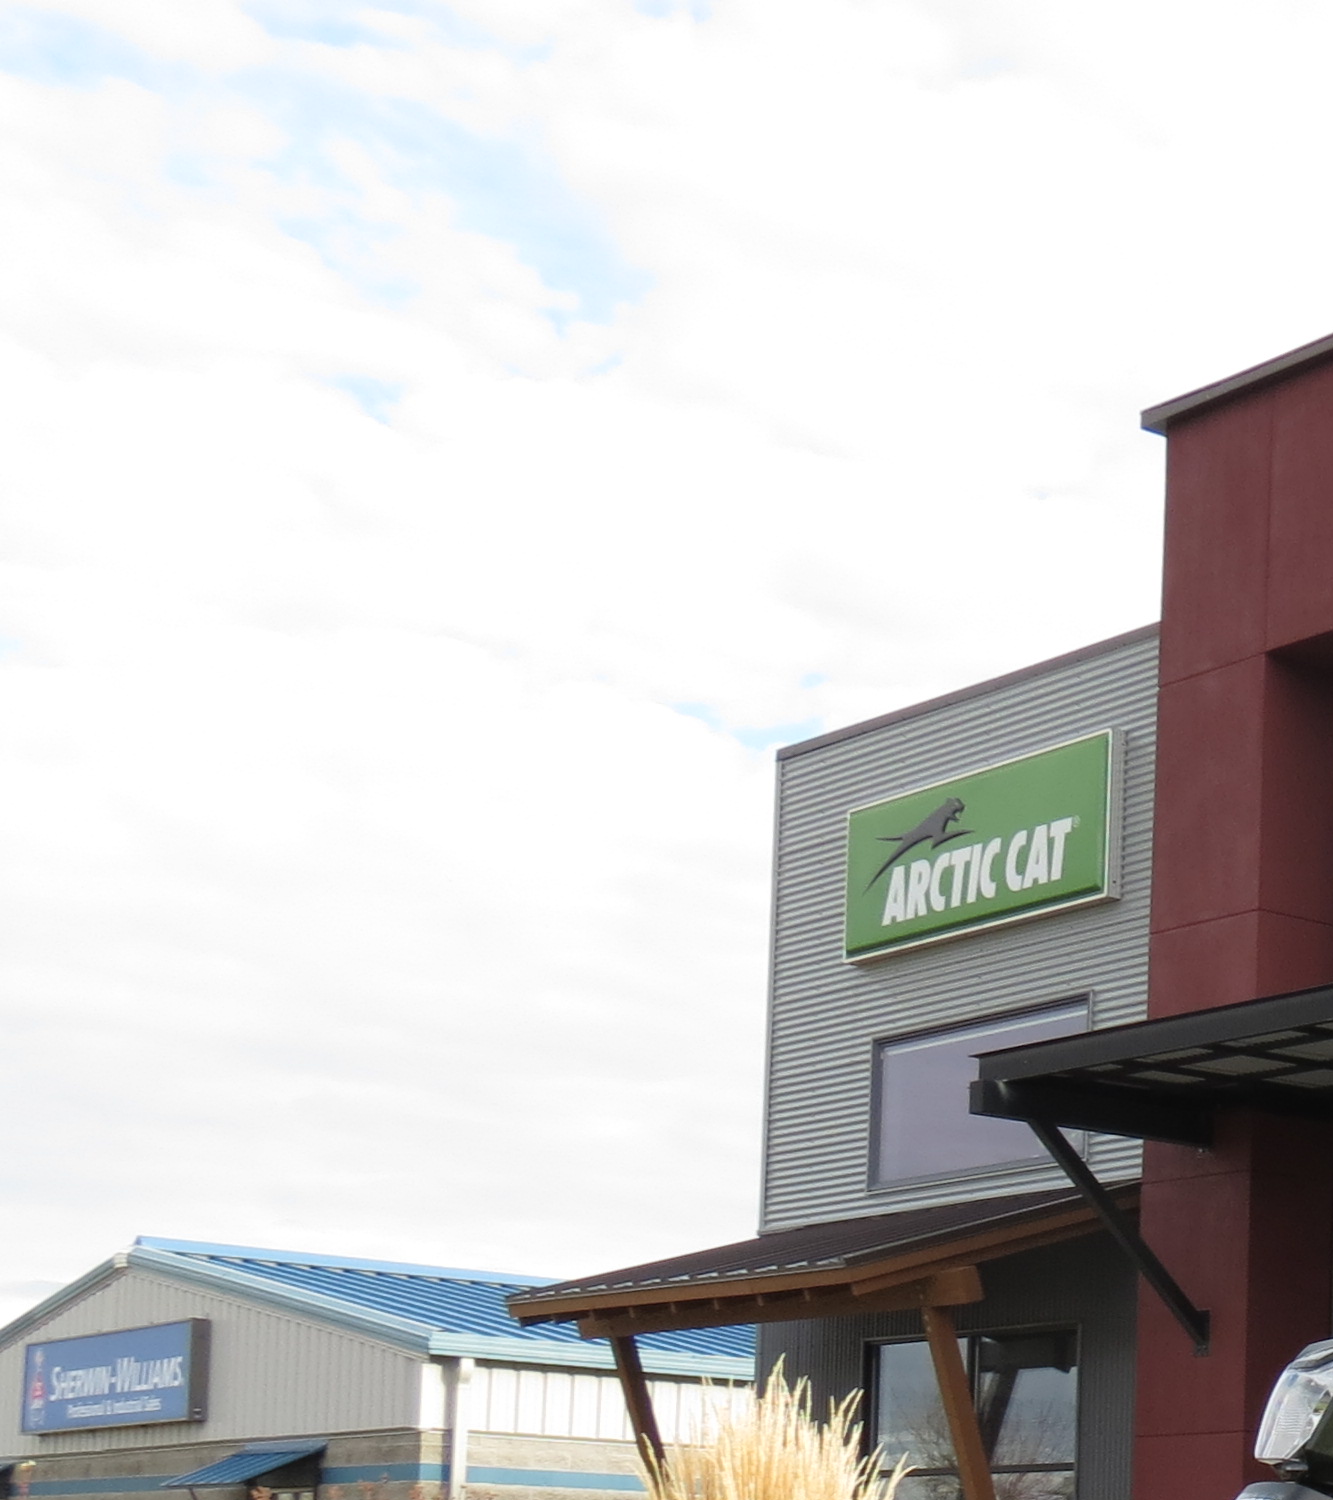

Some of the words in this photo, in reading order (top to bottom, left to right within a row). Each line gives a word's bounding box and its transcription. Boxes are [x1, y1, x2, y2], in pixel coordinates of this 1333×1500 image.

[881, 837, 1001, 926] ARCTIC
[1005, 816, 1074, 893] CAT
[50, 1356, 184, 1401] SHERWIN-WILLIAMS
